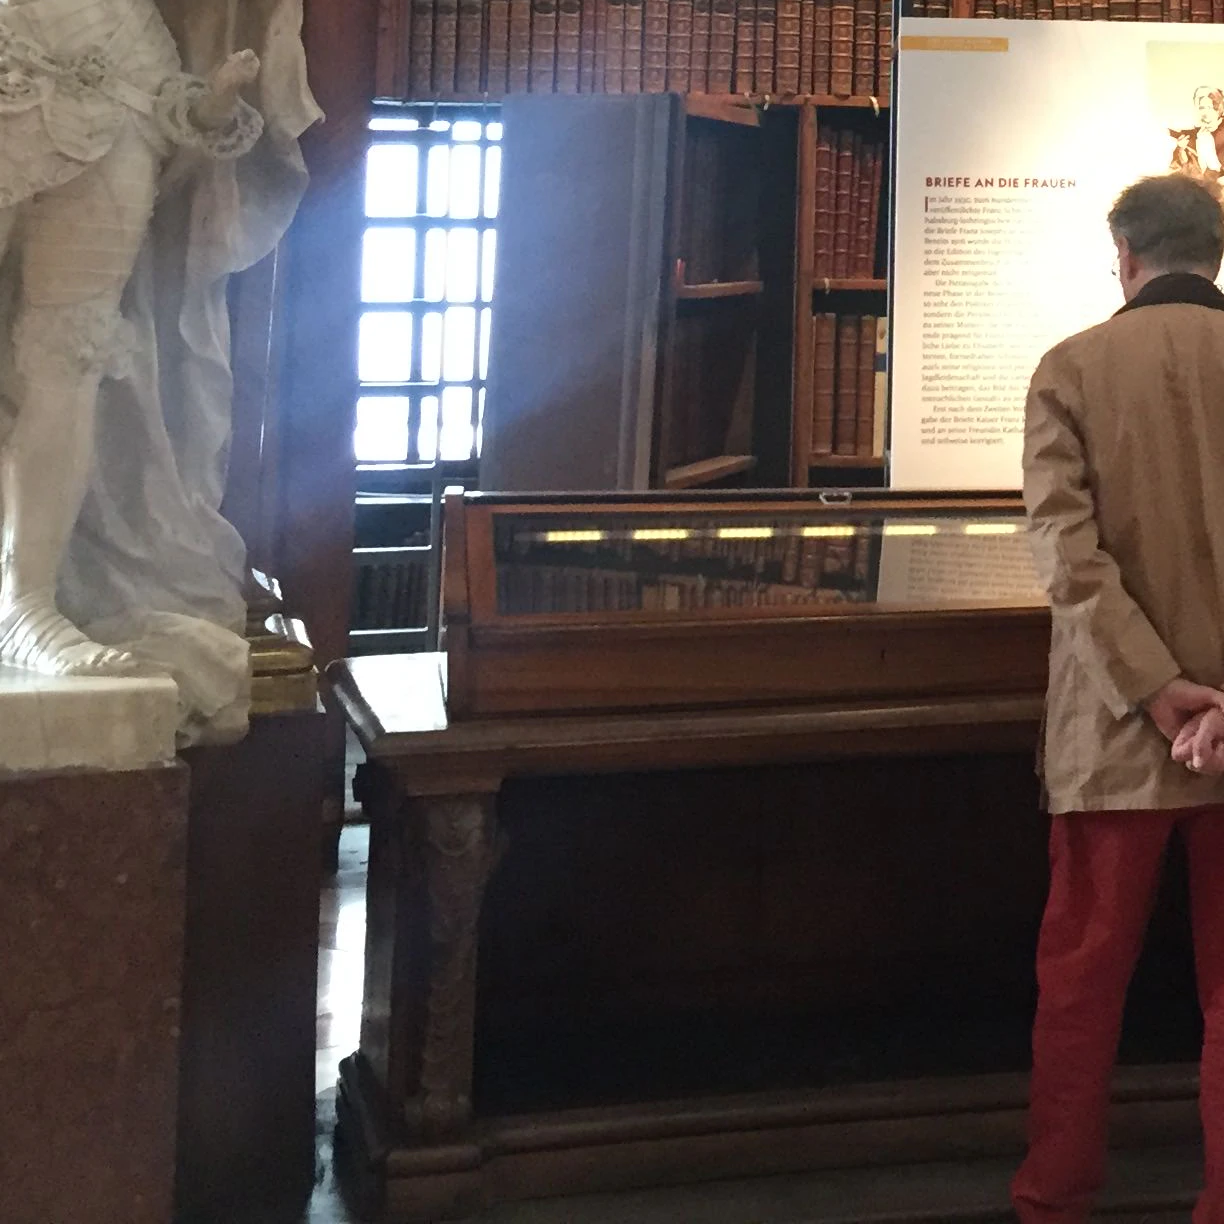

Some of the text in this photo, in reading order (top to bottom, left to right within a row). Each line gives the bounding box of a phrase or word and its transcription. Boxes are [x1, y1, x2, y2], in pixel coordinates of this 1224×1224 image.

[925, 177, 1076, 189] BRIEFE AN DIE FRAUEN
